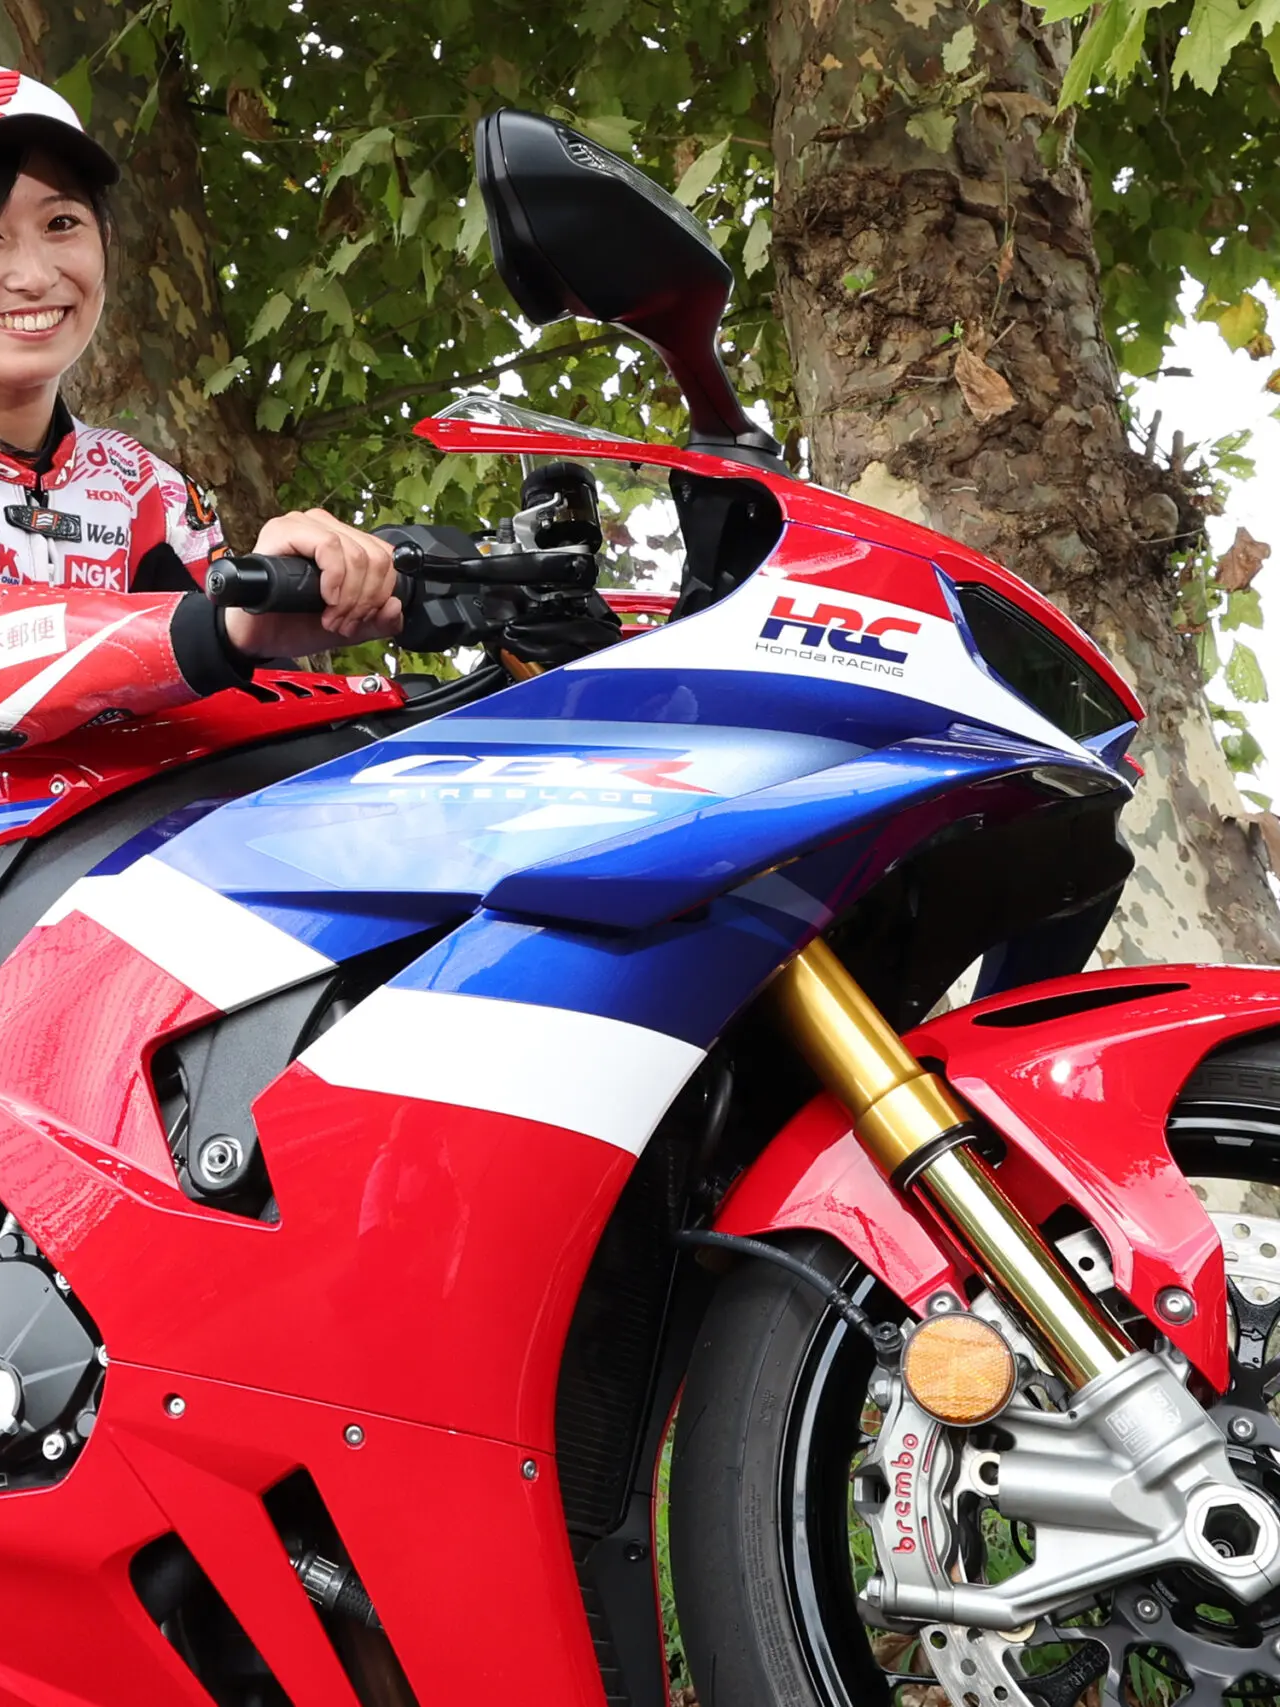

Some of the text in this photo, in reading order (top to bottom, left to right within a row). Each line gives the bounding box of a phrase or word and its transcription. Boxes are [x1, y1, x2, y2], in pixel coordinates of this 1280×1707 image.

[71, 561, 122, 590] NGK
[759, 596, 922, 664] HRC
[755, 642, 904, 677] Honda RACING
[388, 788, 654, 805] FIREBLADE
[890, 1433, 919, 1554] brembo
